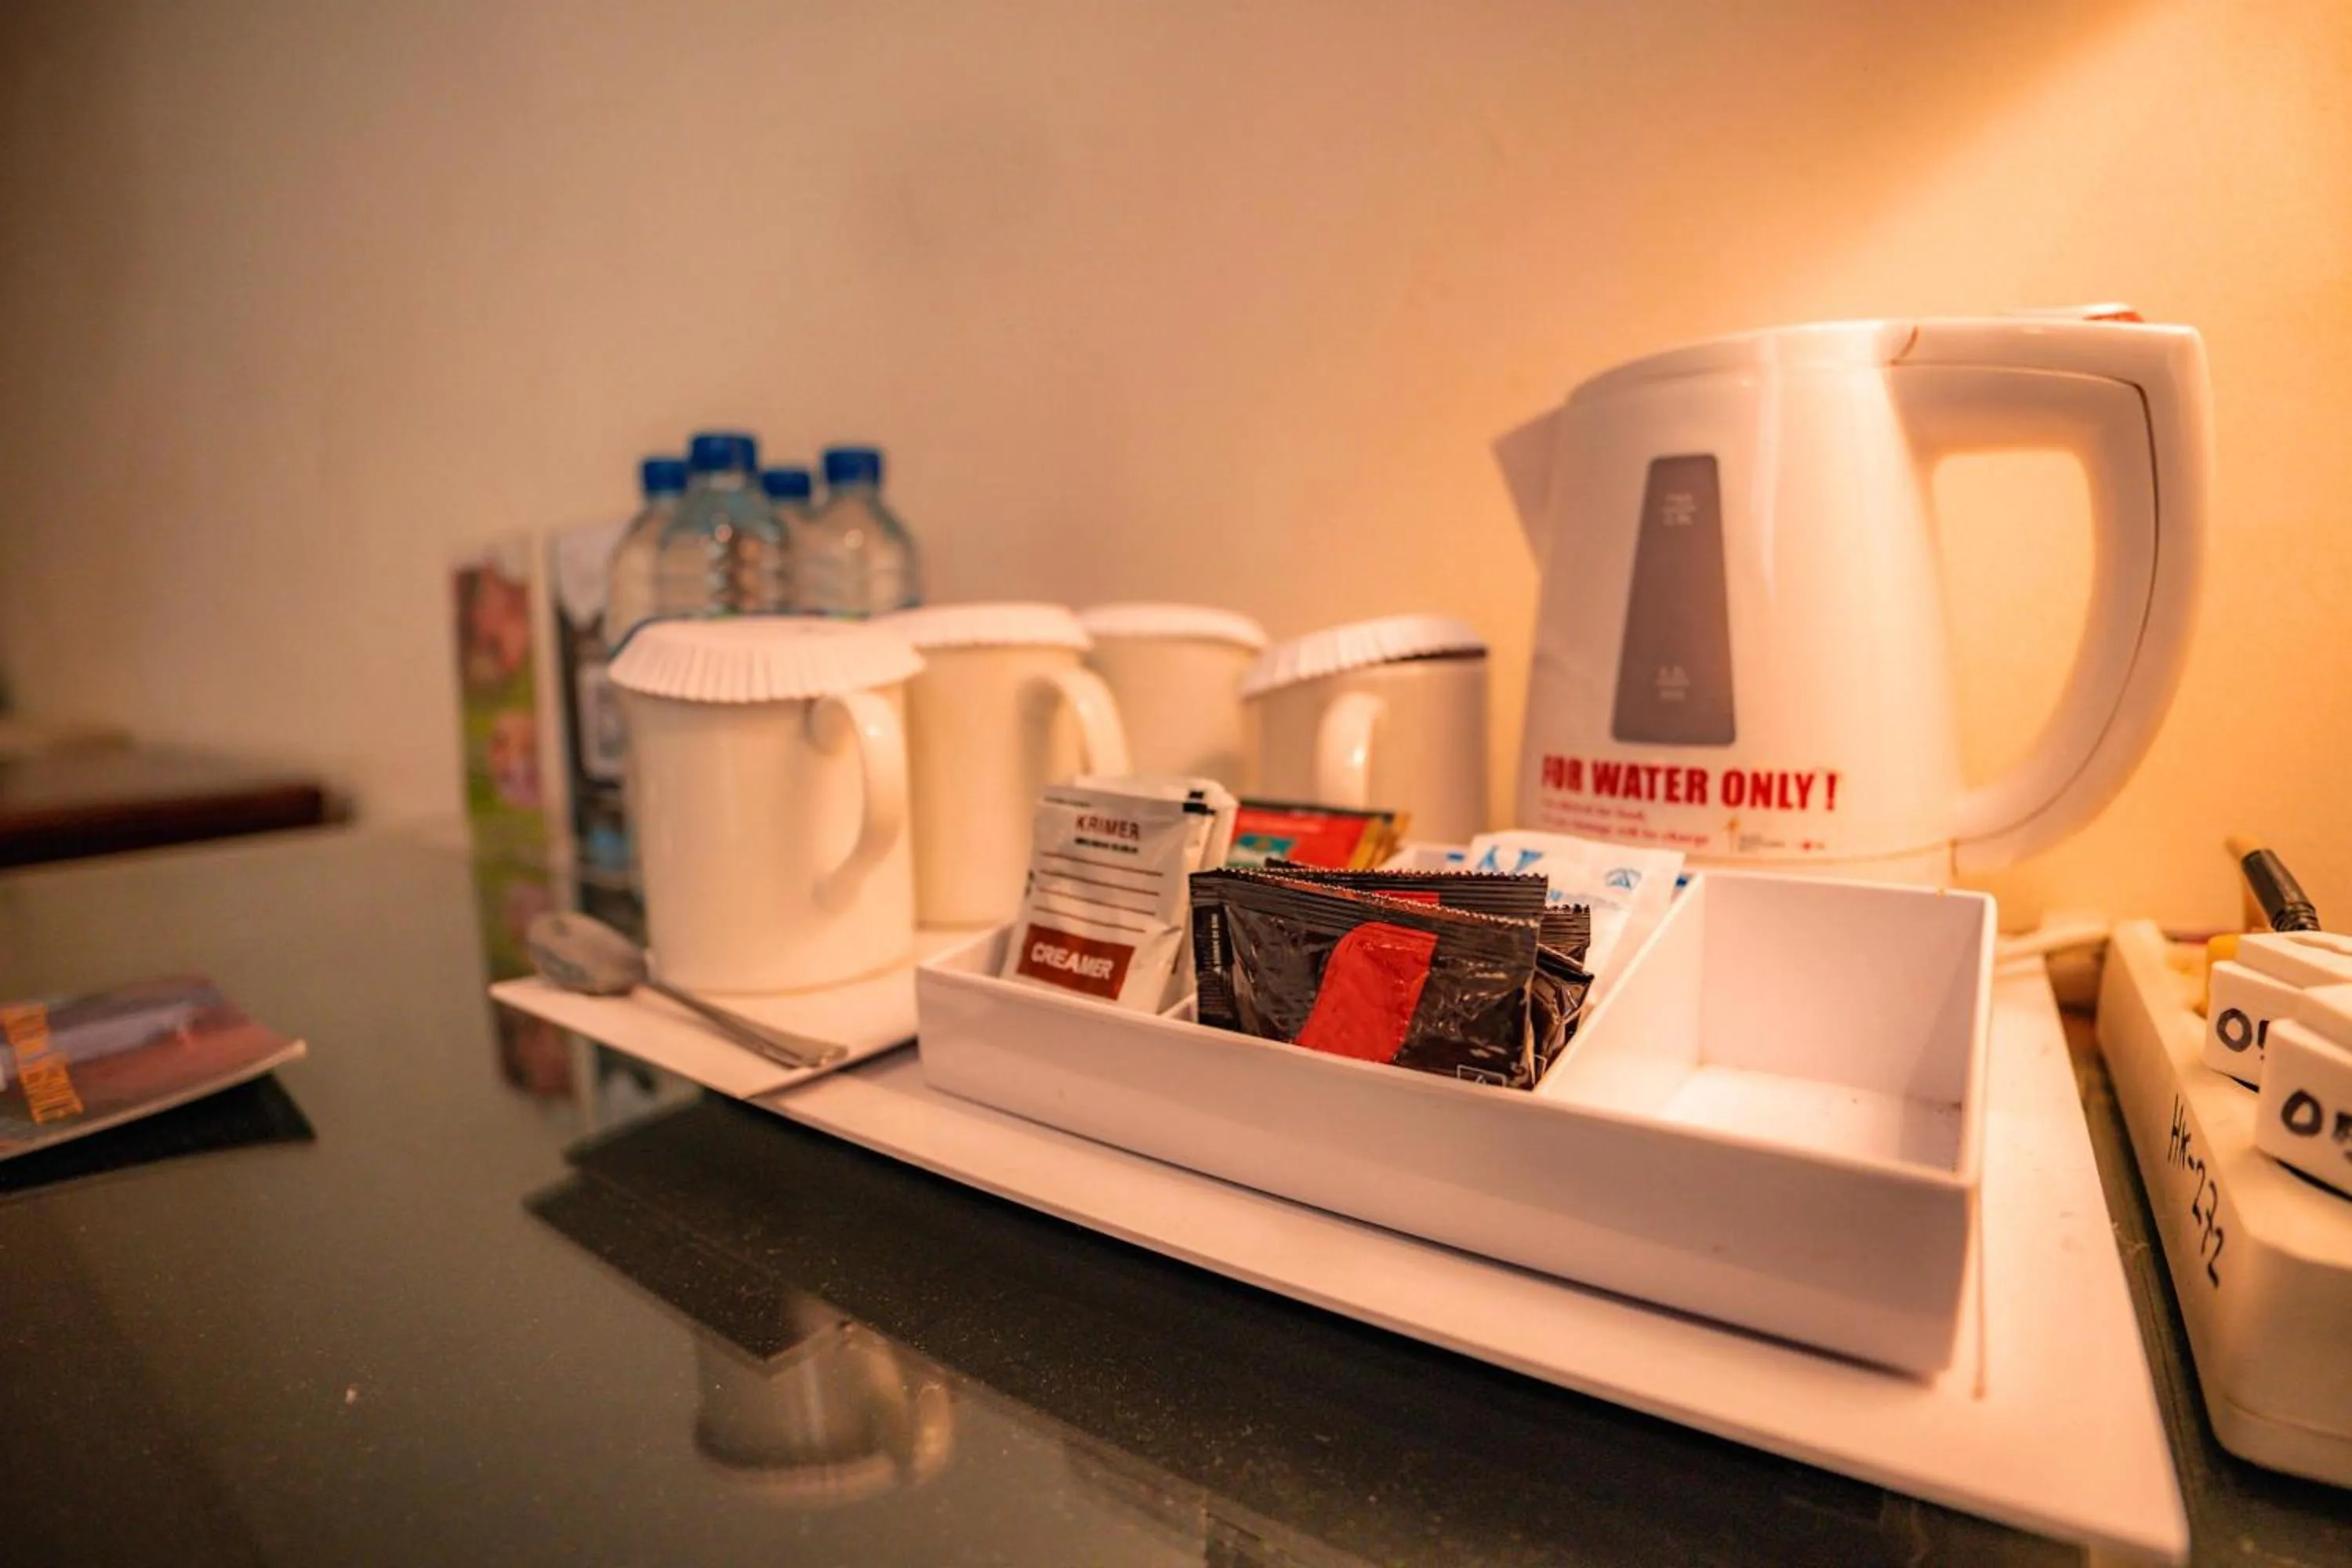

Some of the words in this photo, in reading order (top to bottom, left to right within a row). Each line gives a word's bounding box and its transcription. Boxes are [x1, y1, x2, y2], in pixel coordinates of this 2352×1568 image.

[1542, 755, 1583, 791] FOR
[1592, 760, 1709, 805] WATER
[1721, 770, 1815, 811] ONLY
[1076, 815, 1140, 840] KRIMER
[1031, 942, 1114, 980] CREAMER
